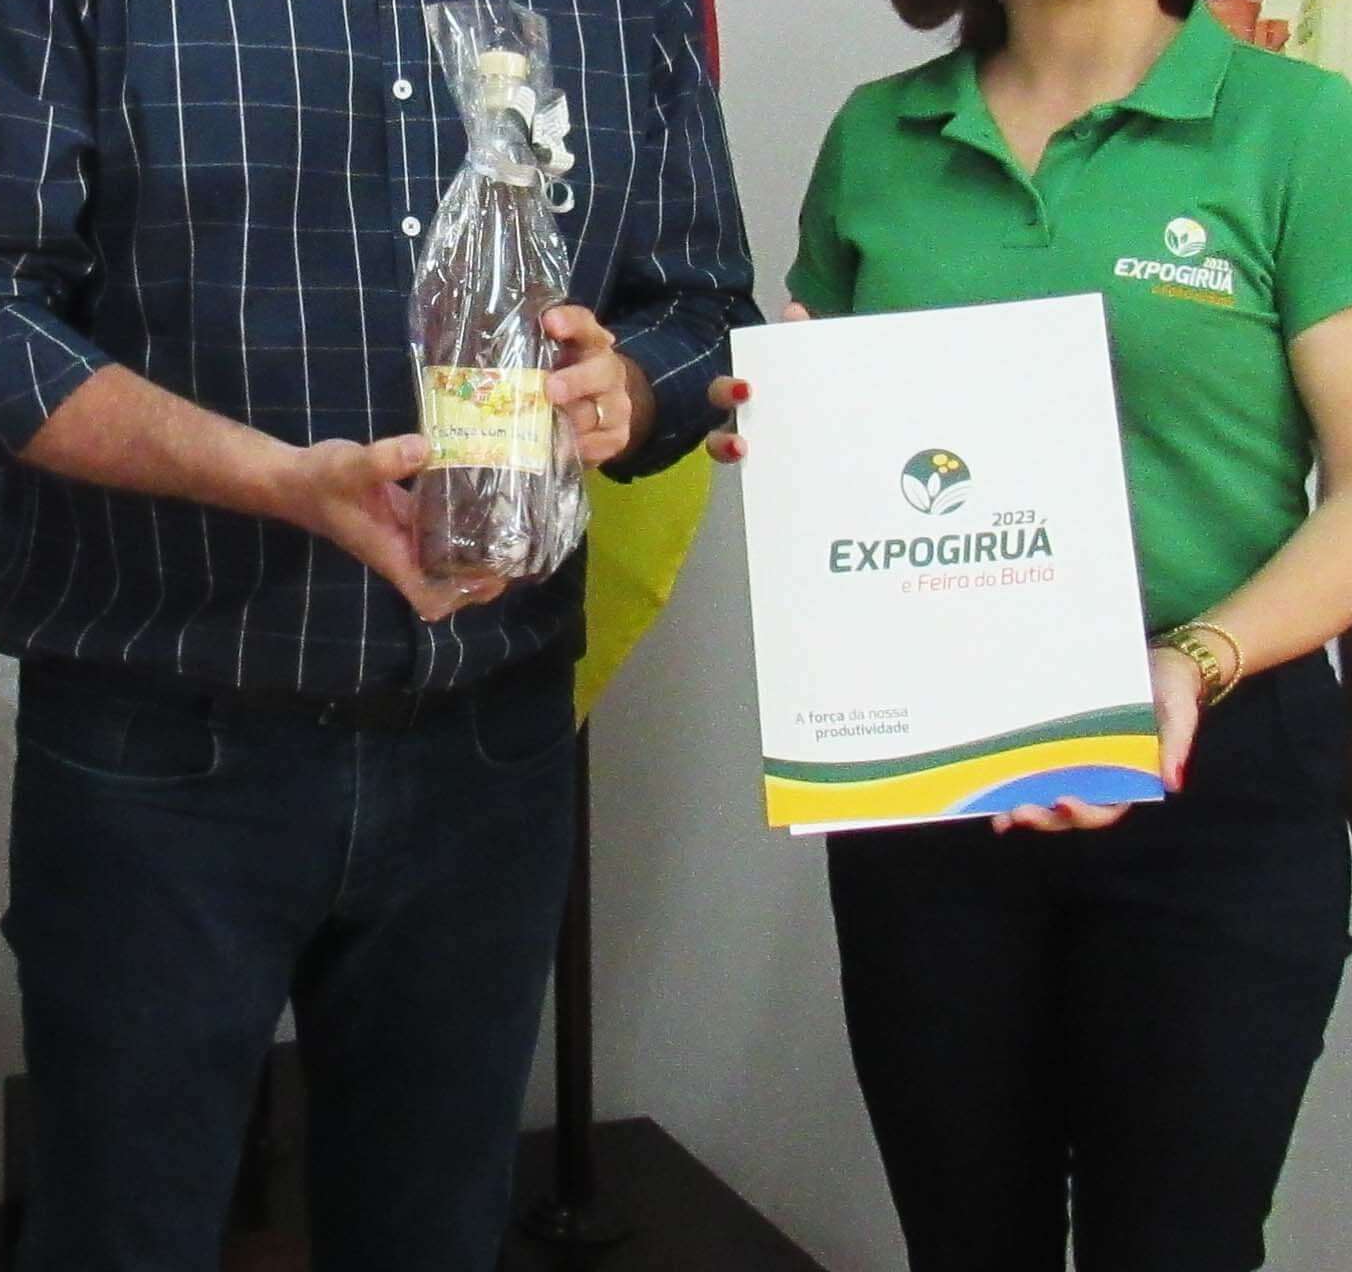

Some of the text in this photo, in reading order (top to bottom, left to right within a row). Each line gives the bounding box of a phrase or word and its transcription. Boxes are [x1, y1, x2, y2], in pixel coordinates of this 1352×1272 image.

[991, 510, 1036, 526] 2023
[829, 518, 1054, 573] EXPOGIRUÁ
[901, 582, 912, 592] e
[917, 573, 969, 591] Feira
[974, 571, 996, 587] do
[795, 708, 908, 724] A força da nossa
[815, 722, 910, 742] produtividade
